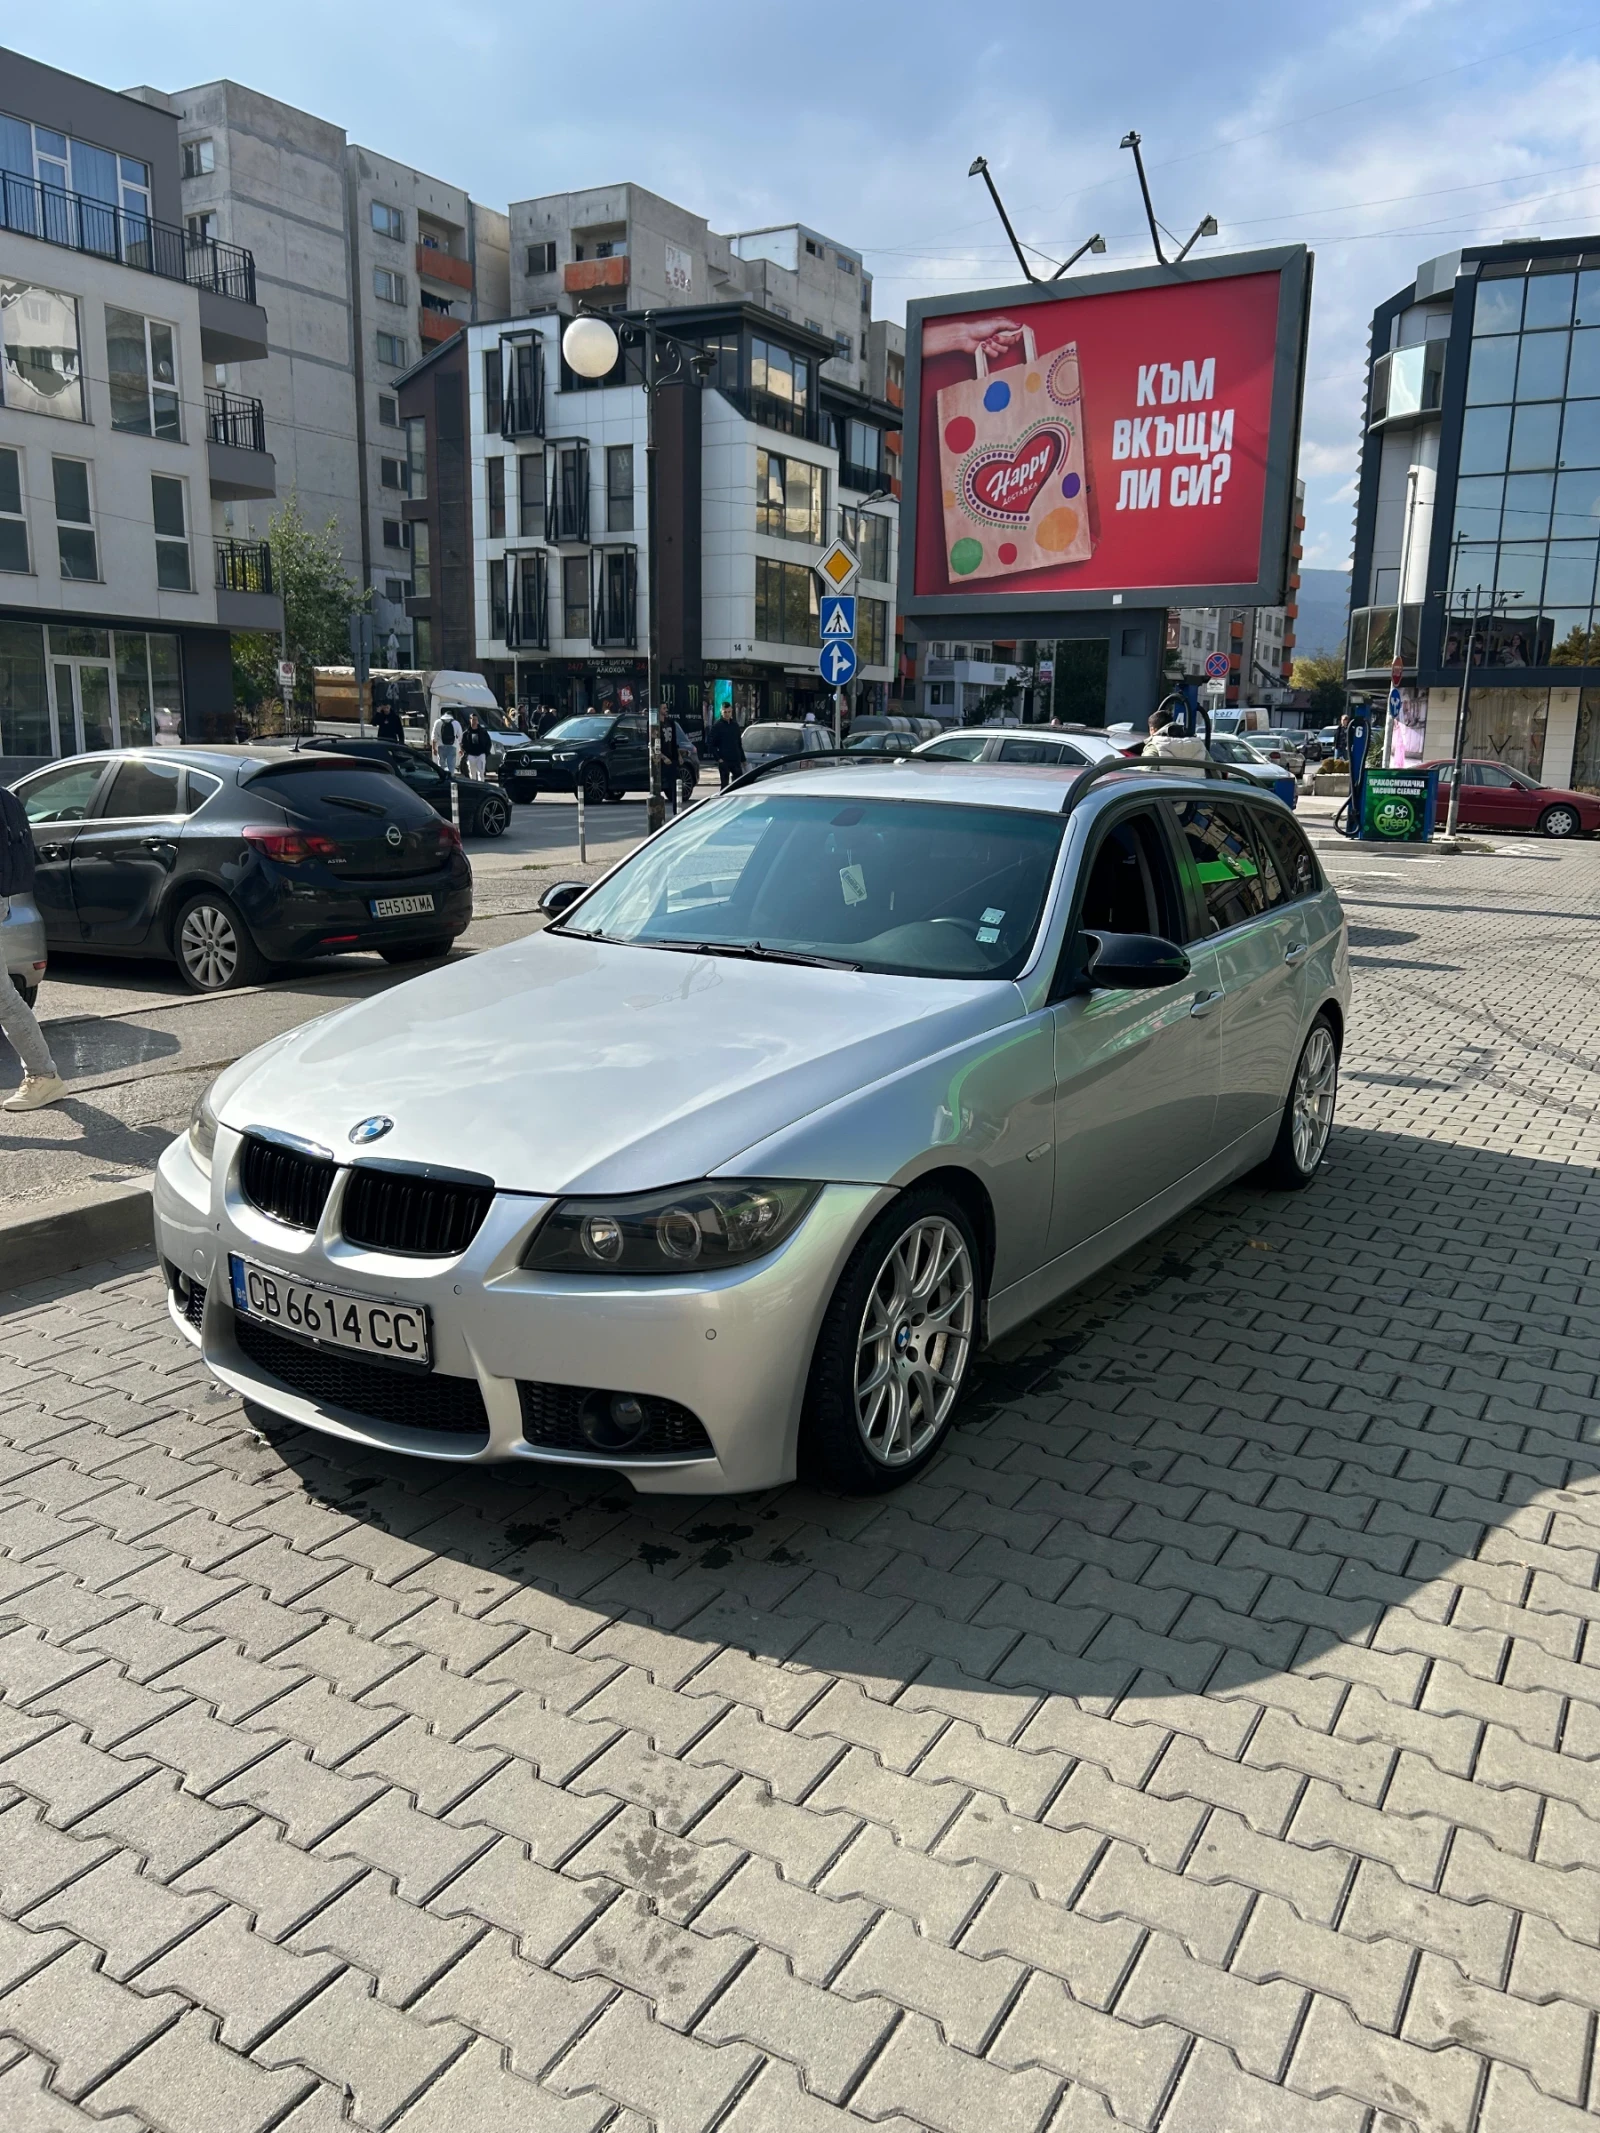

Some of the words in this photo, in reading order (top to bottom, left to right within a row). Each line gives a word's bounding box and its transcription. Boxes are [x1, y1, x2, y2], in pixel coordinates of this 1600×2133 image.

[1136, 357, 1216, 407] КЪМ
[1112, 408, 1235, 461] ВКЪЩИ
[985, 445, 1051, 502] Happy
[1115, 467, 1162, 511] ЛИ
[1169, 453, 1232, 507] СИ?
[1002, 482, 1038, 507] ДОСТАВКА
[734, 644, 742, 652] 14
[1175, 712, 1184, 725] 4
[1355, 726, 1363, 738] 6
[1369, 779, 1425, 788] ПРАХОСМУКАЧКА
[1397, 788, 1421, 796] CLEANER
[1377, 813, 1410, 828] Green
